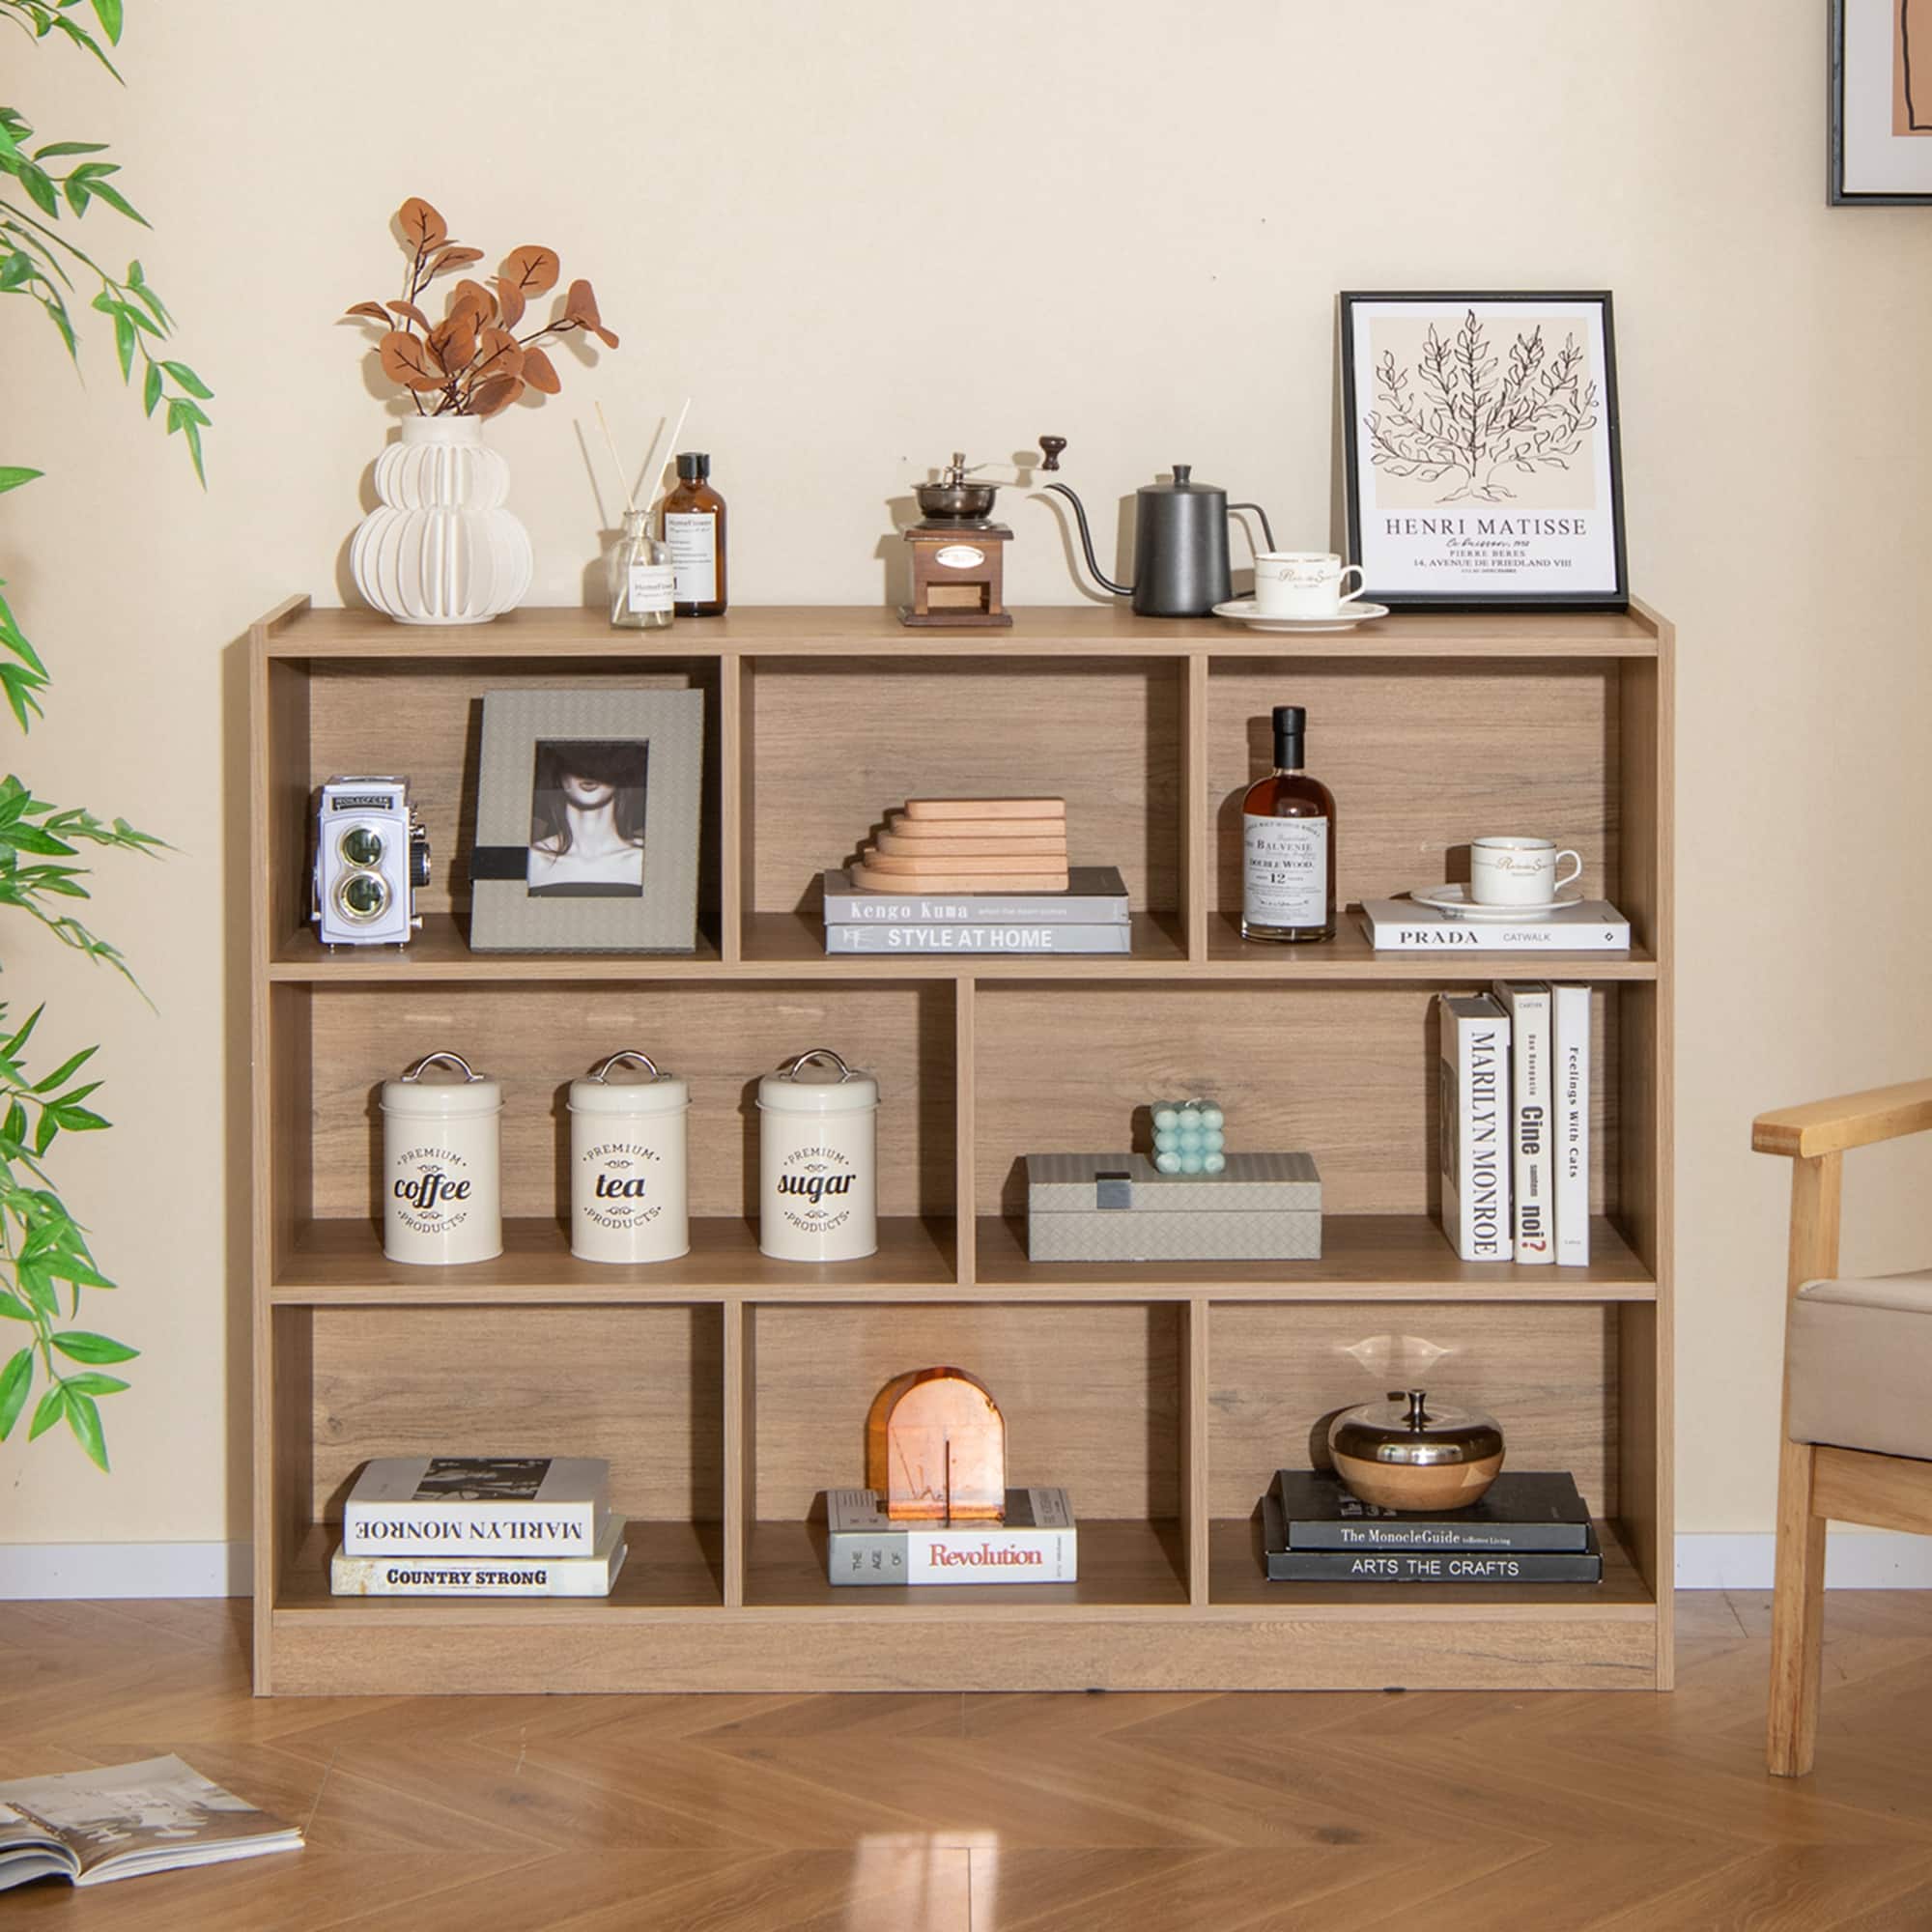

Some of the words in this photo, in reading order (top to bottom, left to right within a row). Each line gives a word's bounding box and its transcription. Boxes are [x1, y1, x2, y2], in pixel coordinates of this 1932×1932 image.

[1386, 519, 1465, 535] HENRI
[1477, 519, 1587, 535] MATISSE
[1270, 872, 1286, 885] 12
[850, 900, 912, 921] Kengo
[921, 900, 968, 919] Kuma
[888, 928, 952, 949] STYLE
[957, 928, 987, 949] AT
[990, 928, 1052, 949] HOME
[1400, 930, 1479, 945] PRADA
[1502, 932, 1552, 943] CATWALK
[1567, 1046, 1579, 1106] Feelings
[1471, 1031, 1497, 1144] MARILYN
[1520, 1105, 1544, 1155] Cine
[1569, 1111, 1579, 1143] With
[401, 1148, 462, 1164] PREMIUM
[586, 1143, 655, 1160] PREMIUM
[787, 1147, 846, 1165] PREMIUM
[1569, 1147, 1579, 1179] Cats
[394, 1173, 472, 1209] coffee
[595, 1174, 645, 1198] tea
[777, 1174, 857, 1205] sugar
[1472, 1150, 1498, 1256] MONROE
[399, 1211, 466, 1235] PRODUCTS
[586, 1207, 659, 1230] PRODUCTS
[785, 1210, 849, 1234] PRODUCTS
[1520, 1205, 1548, 1253] noi?
[355, 1520, 463, 1541] MONROE
[469, 1520, 582, 1541] MARILYN
[1340, 1528, 1365, 1544] The
[1368, 1528, 1461, 1544] MonocleGuide
[851, 1550, 863, 1572] THE
[871, 1549, 882, 1571] AGE
[891, 1551, 902, 1567] OF
[928, 1543, 1043, 1567] Revolution
[386, 1568, 472, 1586] COUNTRY
[474, 1568, 548, 1586] STRONG
[1351, 1560, 1399, 1576] ARTS
[1406, 1560, 1441, 1576] THE
[1448, 1560, 1520, 1577] CRAFTS
